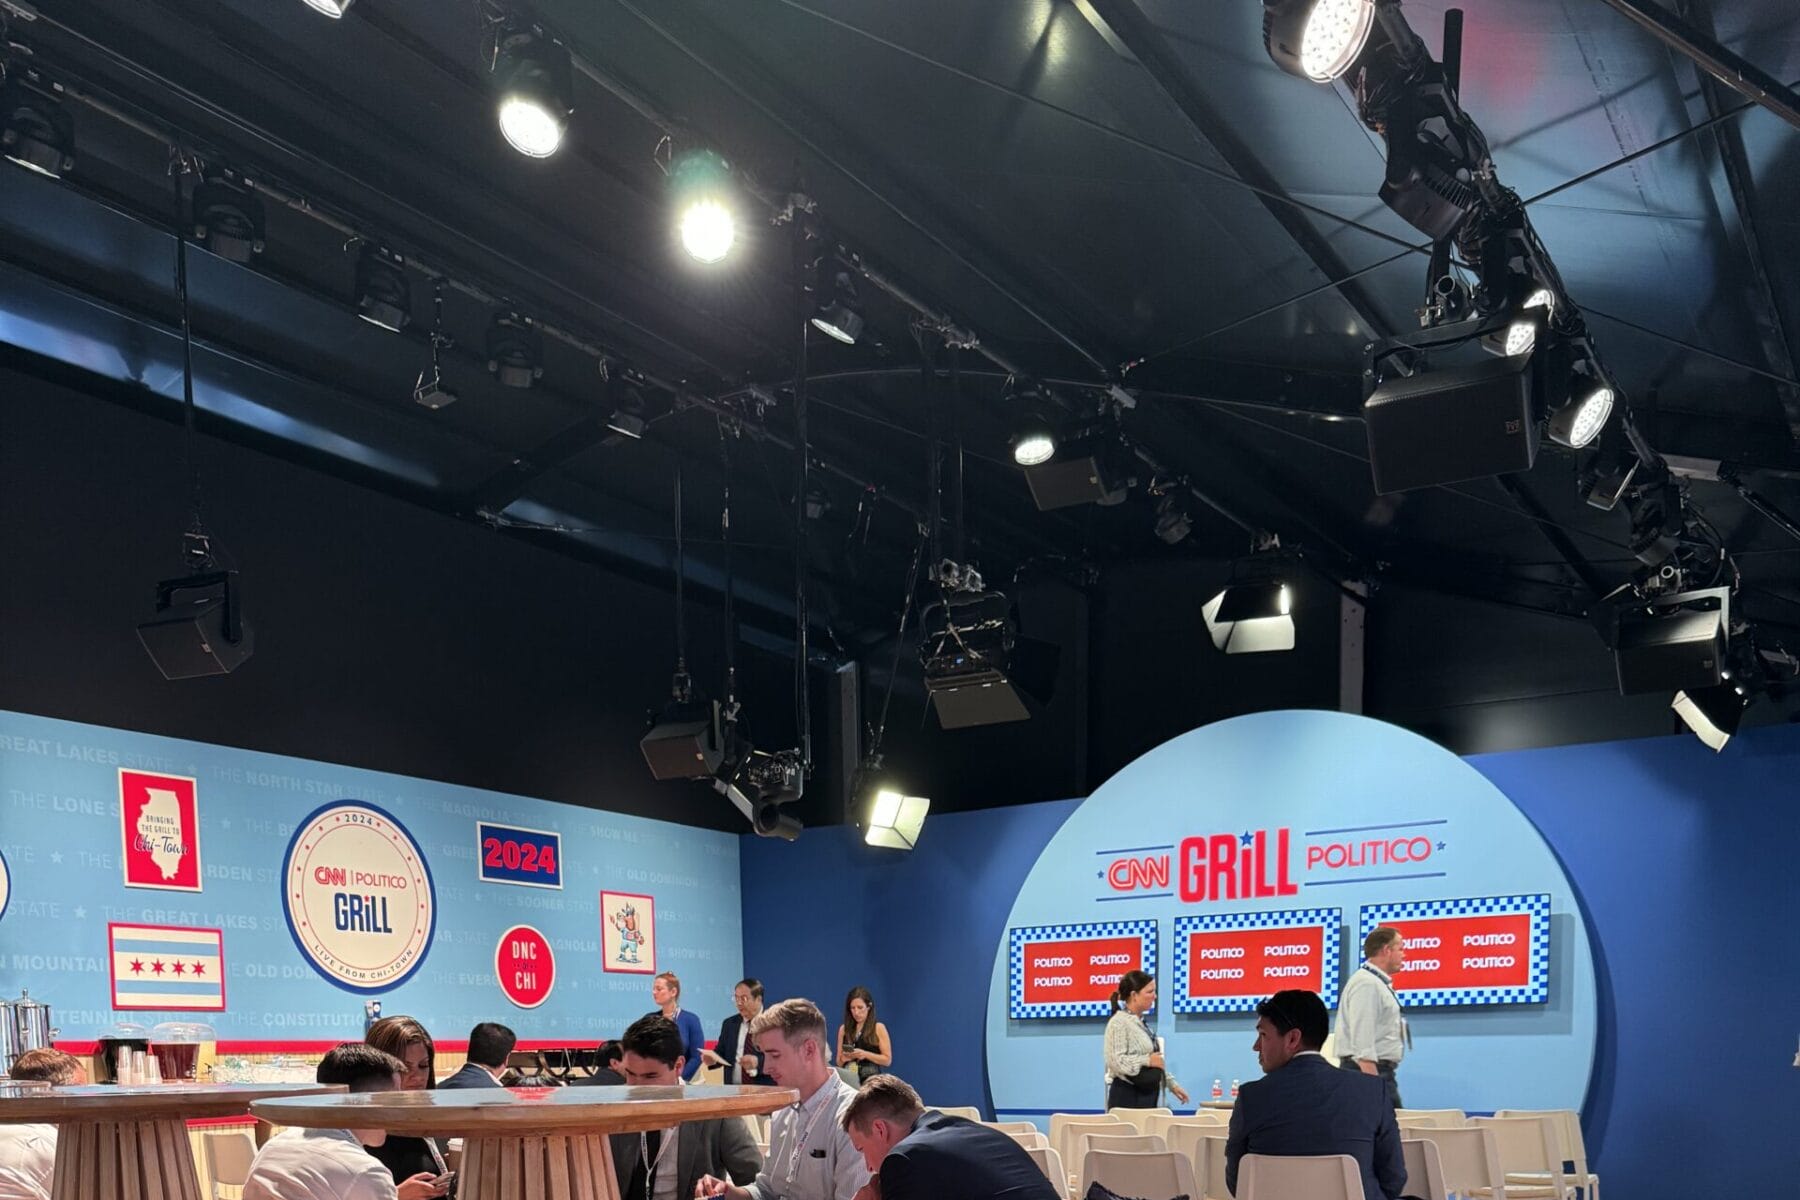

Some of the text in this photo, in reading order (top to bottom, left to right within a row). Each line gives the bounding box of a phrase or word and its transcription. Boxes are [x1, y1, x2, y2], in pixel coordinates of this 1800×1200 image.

[0, 735, 50, 757] REAT
[55, 741, 119, 766] LAKES
[124, 752, 174, 773] STATE
[211, 765, 242, 784] THE
[246, 770, 301, 791] NORTH
[304, 778, 344, 798] STAR
[442, 800, 511, 823] MAGNOLIA
[9, 789, 47, 810] THE
[52, 795, 107, 816] LONE
[146, 815, 174, 825] BRINGING
[244, 817, 272, 834] THE
[344, 813, 373, 826] 2024
[142, 824, 153, 833] THE
[155, 825, 171, 835] GRILL
[79, 851, 112, 869] THE
[442, 844, 477, 860] GREE
[483, 837, 556, 874] 2024
[1108, 854, 1170, 892] CNN
[1306, 836, 1432, 870] POLITICO
[314, 866, 407, 890] CNN POLITICO
[627, 869, 648, 883] OLD
[8, 900, 60, 919] STATE
[104, 905, 137, 920] THE
[142, 911, 198, 927] GREAT
[204, 914, 257, 930] LAKES
[552, 937, 598, 952] AGNOLIA
[1402, 933, 1516, 949] OLITICO POLITICO
[511, 940, 537, 960] DNC
[1200, 944, 1311, 960] POLITICO POLITICO
[13, 954, 104, 973] MOUNTAI
[314, 944, 335, 966] LIVE
[339, 965, 366, 979] FROM
[370, 949, 413, 979] CHI-TOWN
[1034, 954, 1130, 968] POLITICO POLITICO
[1400, 956, 1515, 971] OLITICO POLITICO
[245, 963, 277, 979] OLD
[1200, 965, 1310, 980] POLITICO POLITICO
[459, 973, 498, 987] EVERG
[515, 971, 537, 990] CHI
[609, 979, 650, 993] MOUNTA
[1034, 974, 1121, 987] POLITICO POLITIC
[50, 1008, 134, 1027] TENNIAL
[229, 1011, 258, 1027] THE
[263, 1012, 365, 1028] CONSTITUTIO
[587, 1017, 631, 1031] SUNSHI
